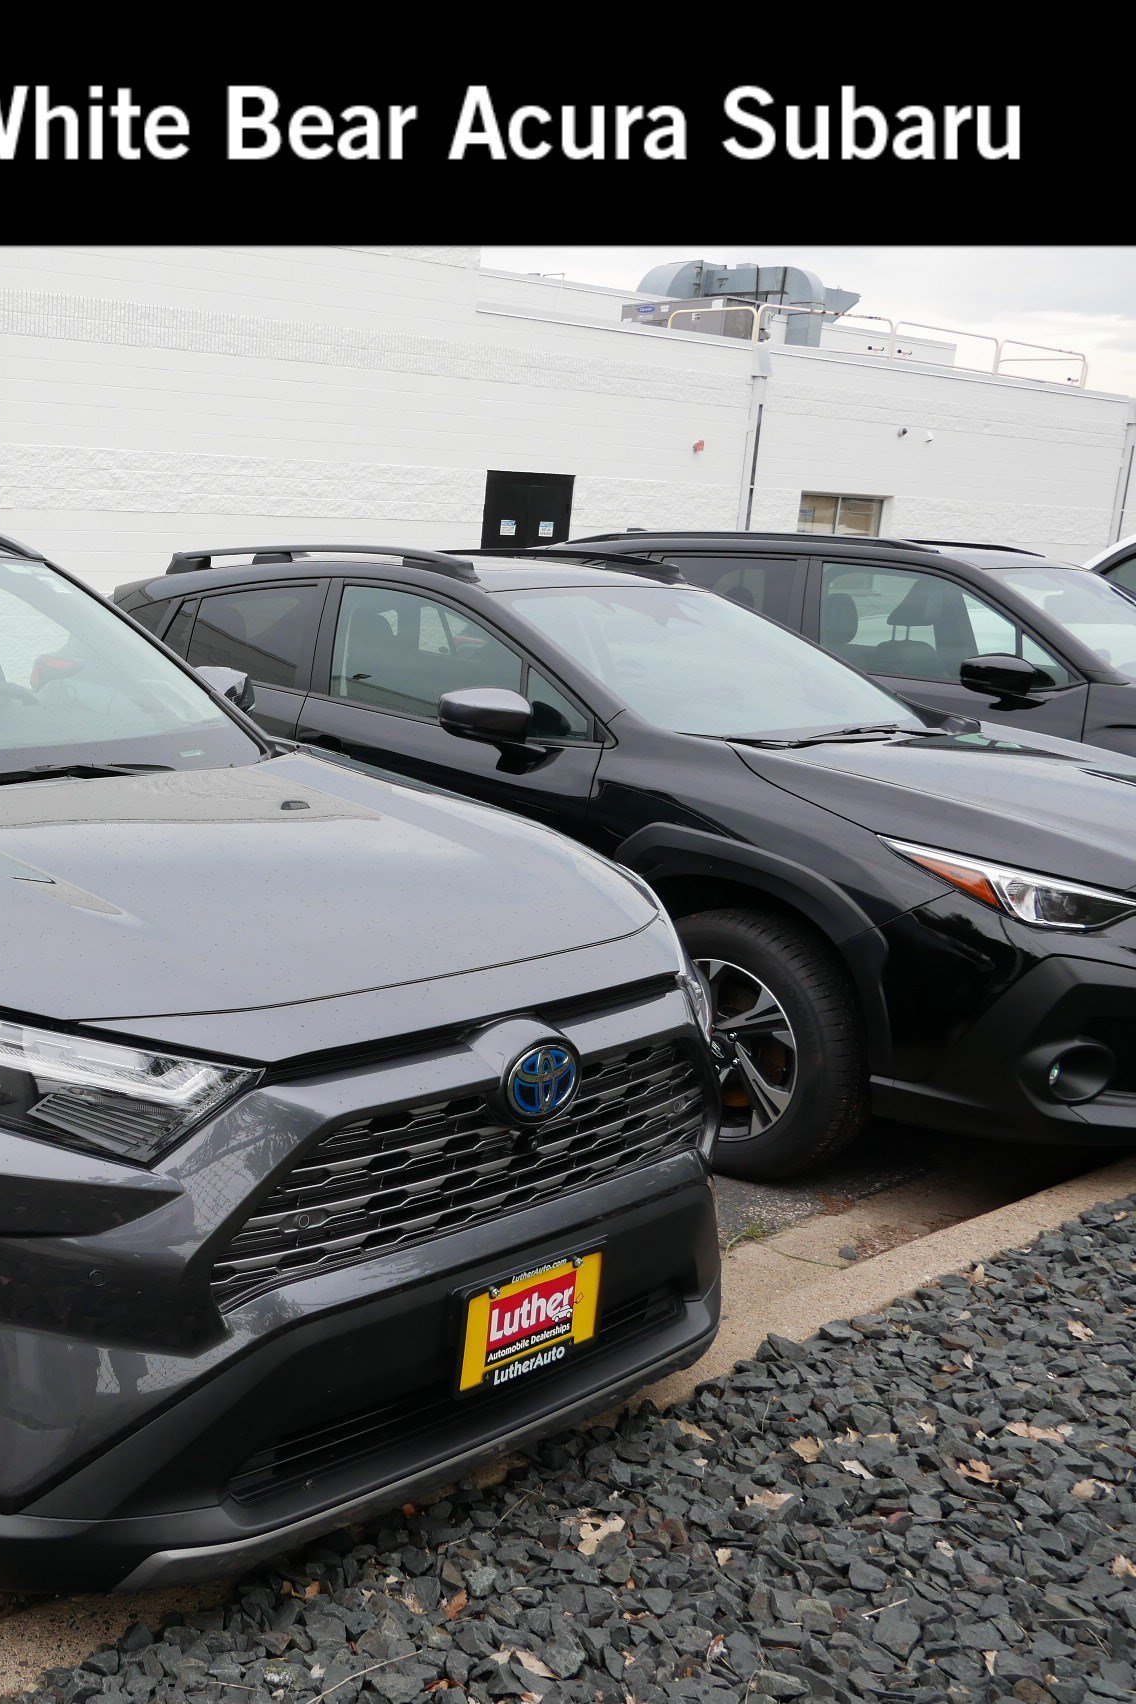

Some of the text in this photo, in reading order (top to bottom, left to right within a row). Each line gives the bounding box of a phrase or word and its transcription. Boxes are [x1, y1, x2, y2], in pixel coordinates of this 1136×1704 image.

[512, 1258, 567, 1284] LutherAuto.com
[490, 1286, 574, 1342] Luther
[487, 1322, 570, 1363] Automobile Dealerships
[493, 1346, 565, 1386] LutherAuto
